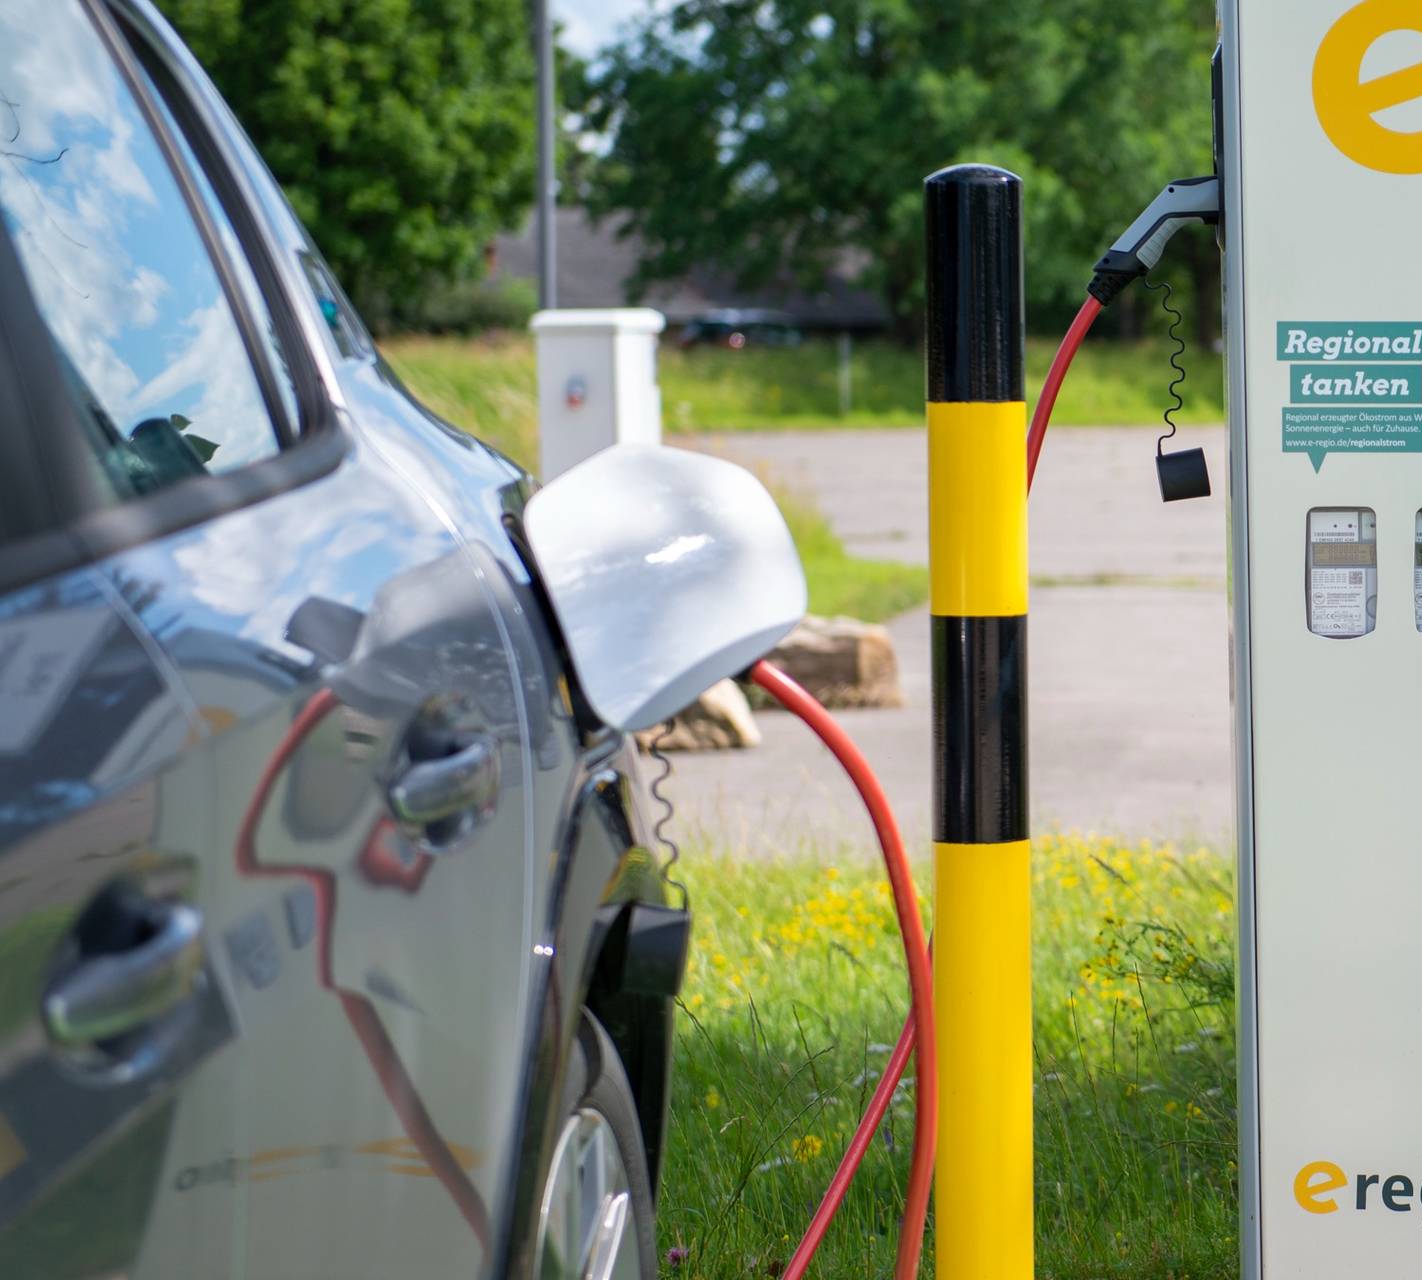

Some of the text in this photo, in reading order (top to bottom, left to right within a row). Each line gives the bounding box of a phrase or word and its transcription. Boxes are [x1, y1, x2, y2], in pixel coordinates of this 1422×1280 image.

[1301, 371, 1410, 396] tanken
[1285, 413, 1319, 423] Regional
[1320, 415, 1357, 423] erzeugter
[1359, 412, 1397, 422] Ökostrom
[1285, 424, 1344, 434] Sonnenenergie
[1352, 424, 1371, 433] auch
[1372, 424, 1384, 433] für
[1385, 424, 1421, 433] Zuhause.
[1285, 438, 1406, 448] www.e-regio.de/regionalstrom
